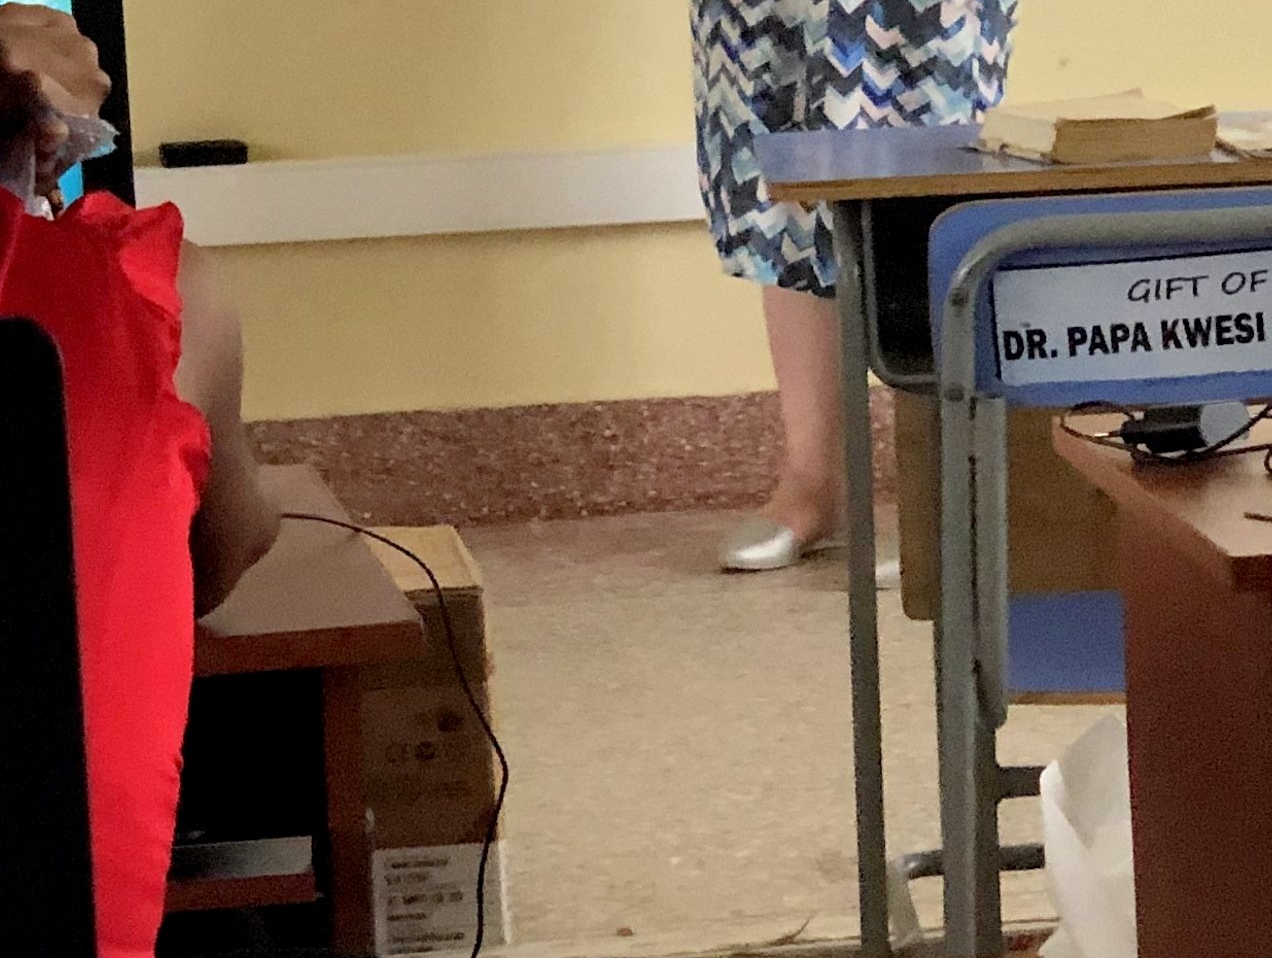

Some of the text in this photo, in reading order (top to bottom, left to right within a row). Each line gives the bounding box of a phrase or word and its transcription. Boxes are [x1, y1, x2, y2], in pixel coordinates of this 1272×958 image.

[1127, 269, 1269, 303] GIFT OF
[1002, 328, 1058, 360] DR.
[1067, 321, 1152, 357] PAPA
[1161, 311, 1266, 350] KWESI
